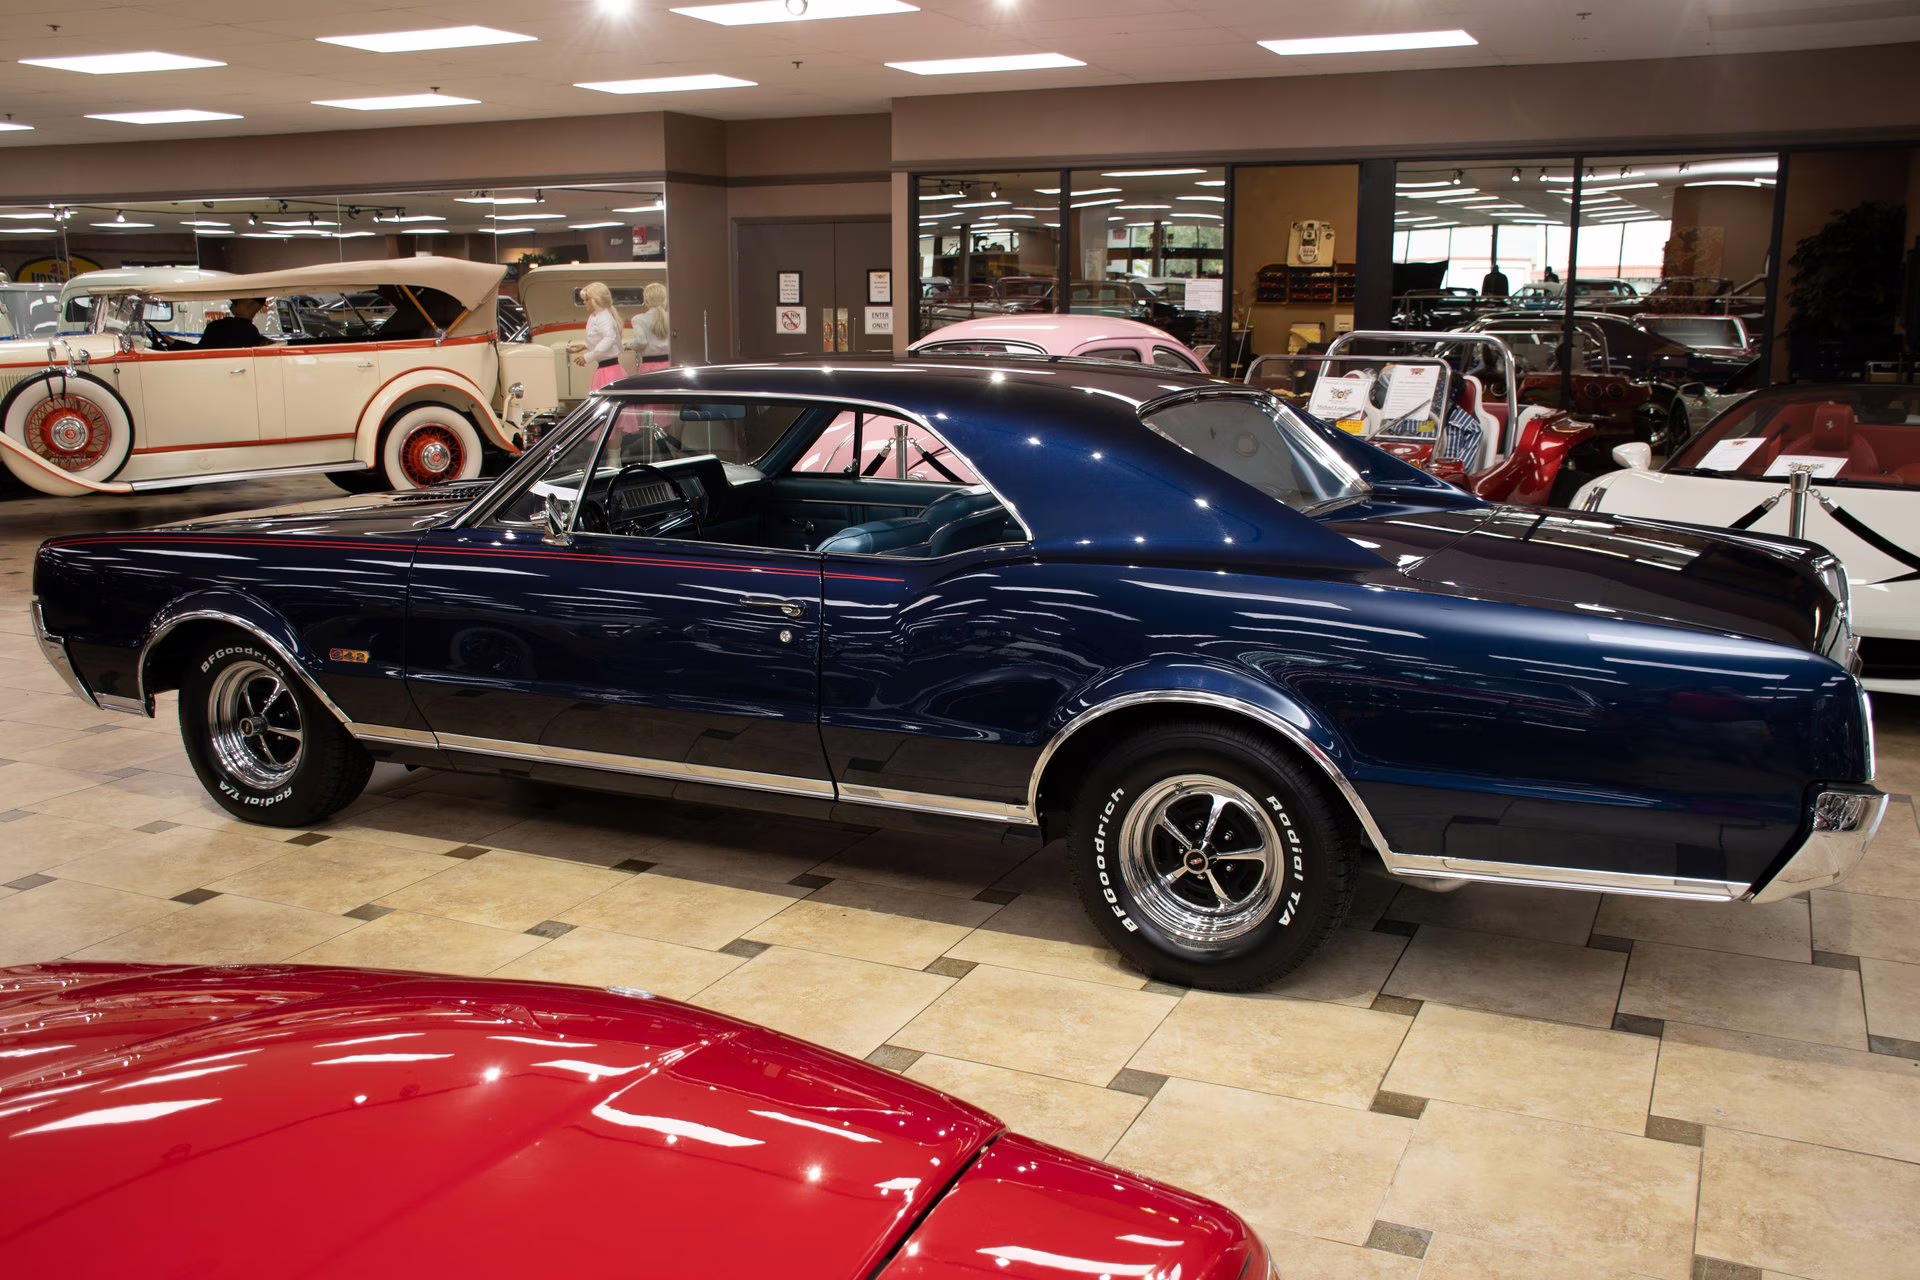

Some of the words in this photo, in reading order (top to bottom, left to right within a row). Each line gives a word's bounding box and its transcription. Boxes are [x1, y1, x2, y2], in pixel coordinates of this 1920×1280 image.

[201, 647, 285, 677] BFGoodrich
[219, 780, 240, 801] T/A
[244, 786, 293, 807] Radial
[1266, 795, 1304, 881] Radial
[1094, 787, 1139, 932] BFGoodrich
[1278, 891, 1301, 926] T/A
